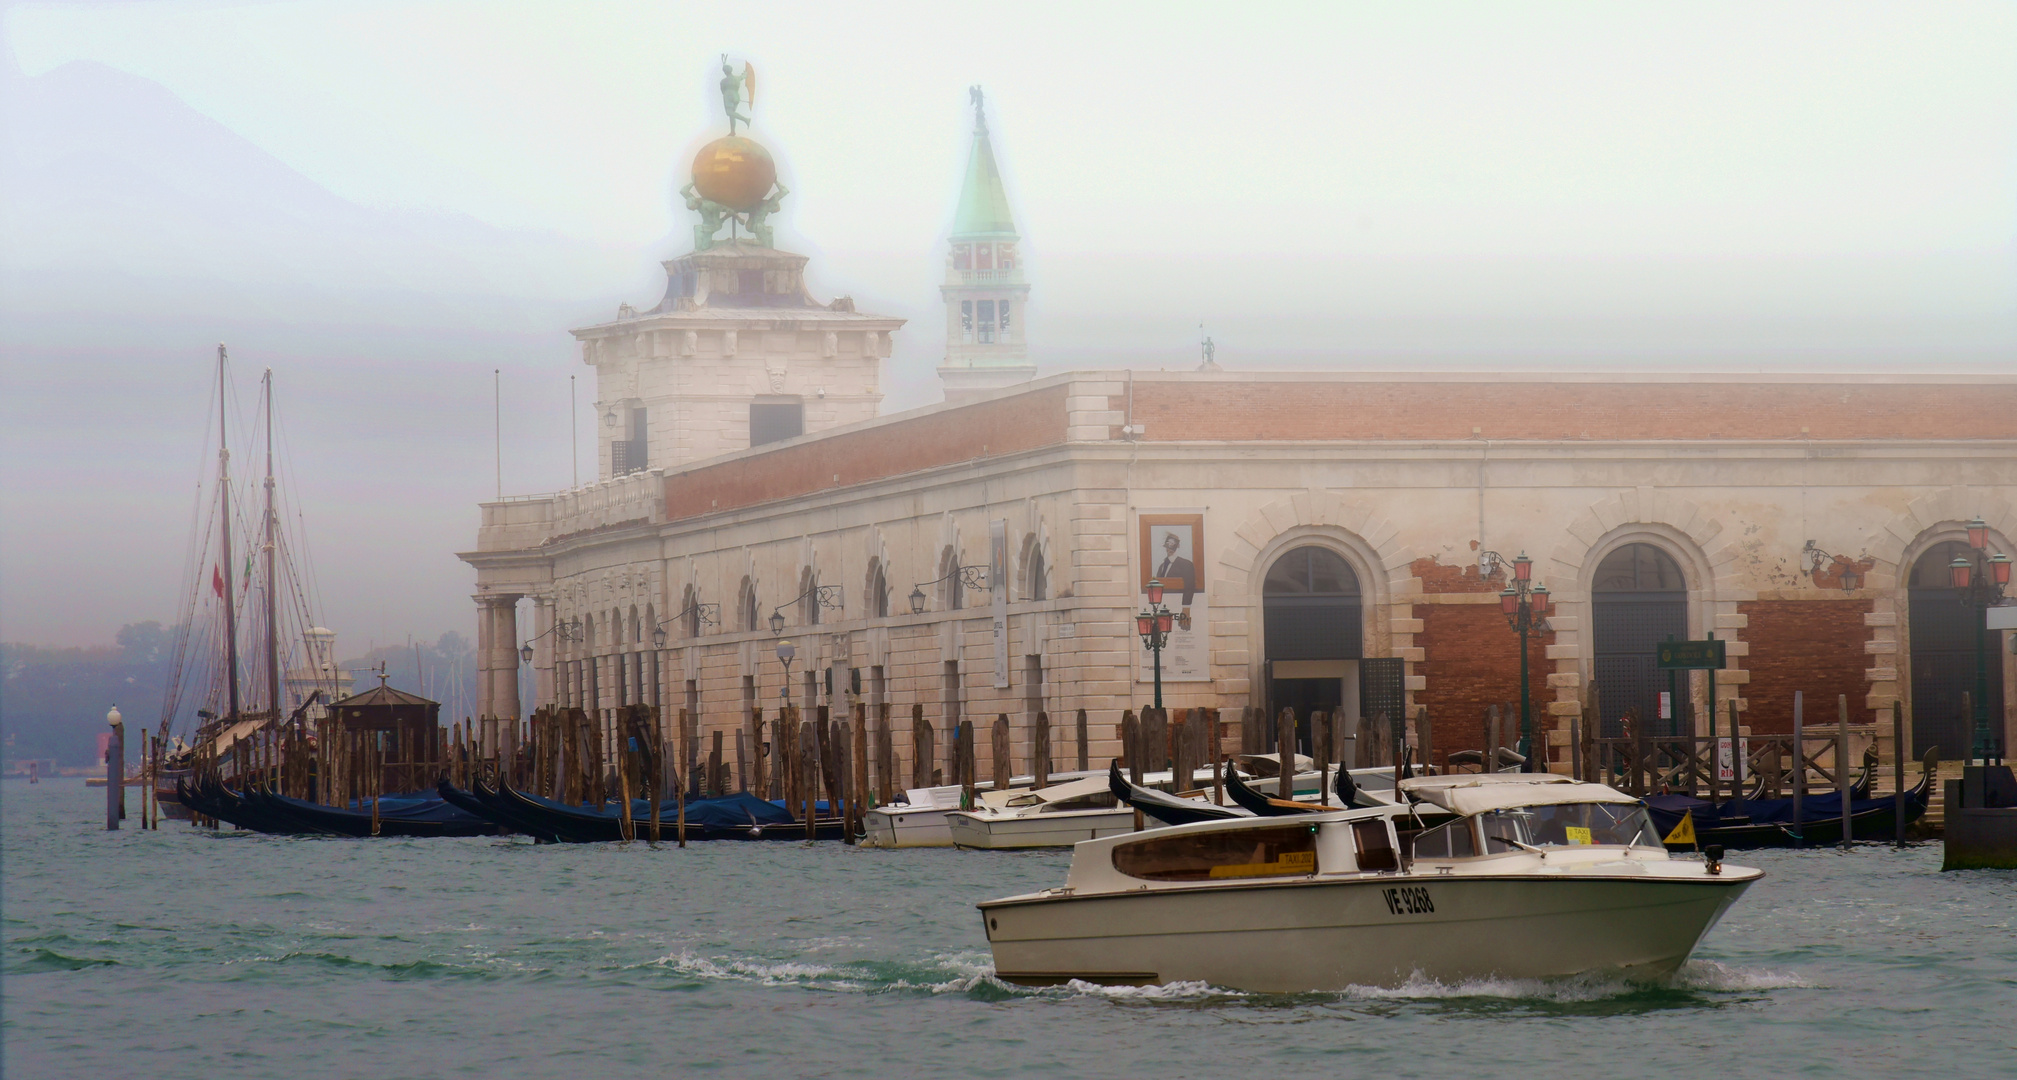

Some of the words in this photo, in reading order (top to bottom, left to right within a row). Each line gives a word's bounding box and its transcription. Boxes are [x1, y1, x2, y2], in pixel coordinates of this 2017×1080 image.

[1720, 769, 1734, 777] RID
[1285, 854, 1300, 865] TAXI
[1382, 888, 1405, 915] VE
[1401, 886, 1435, 914] 9268
